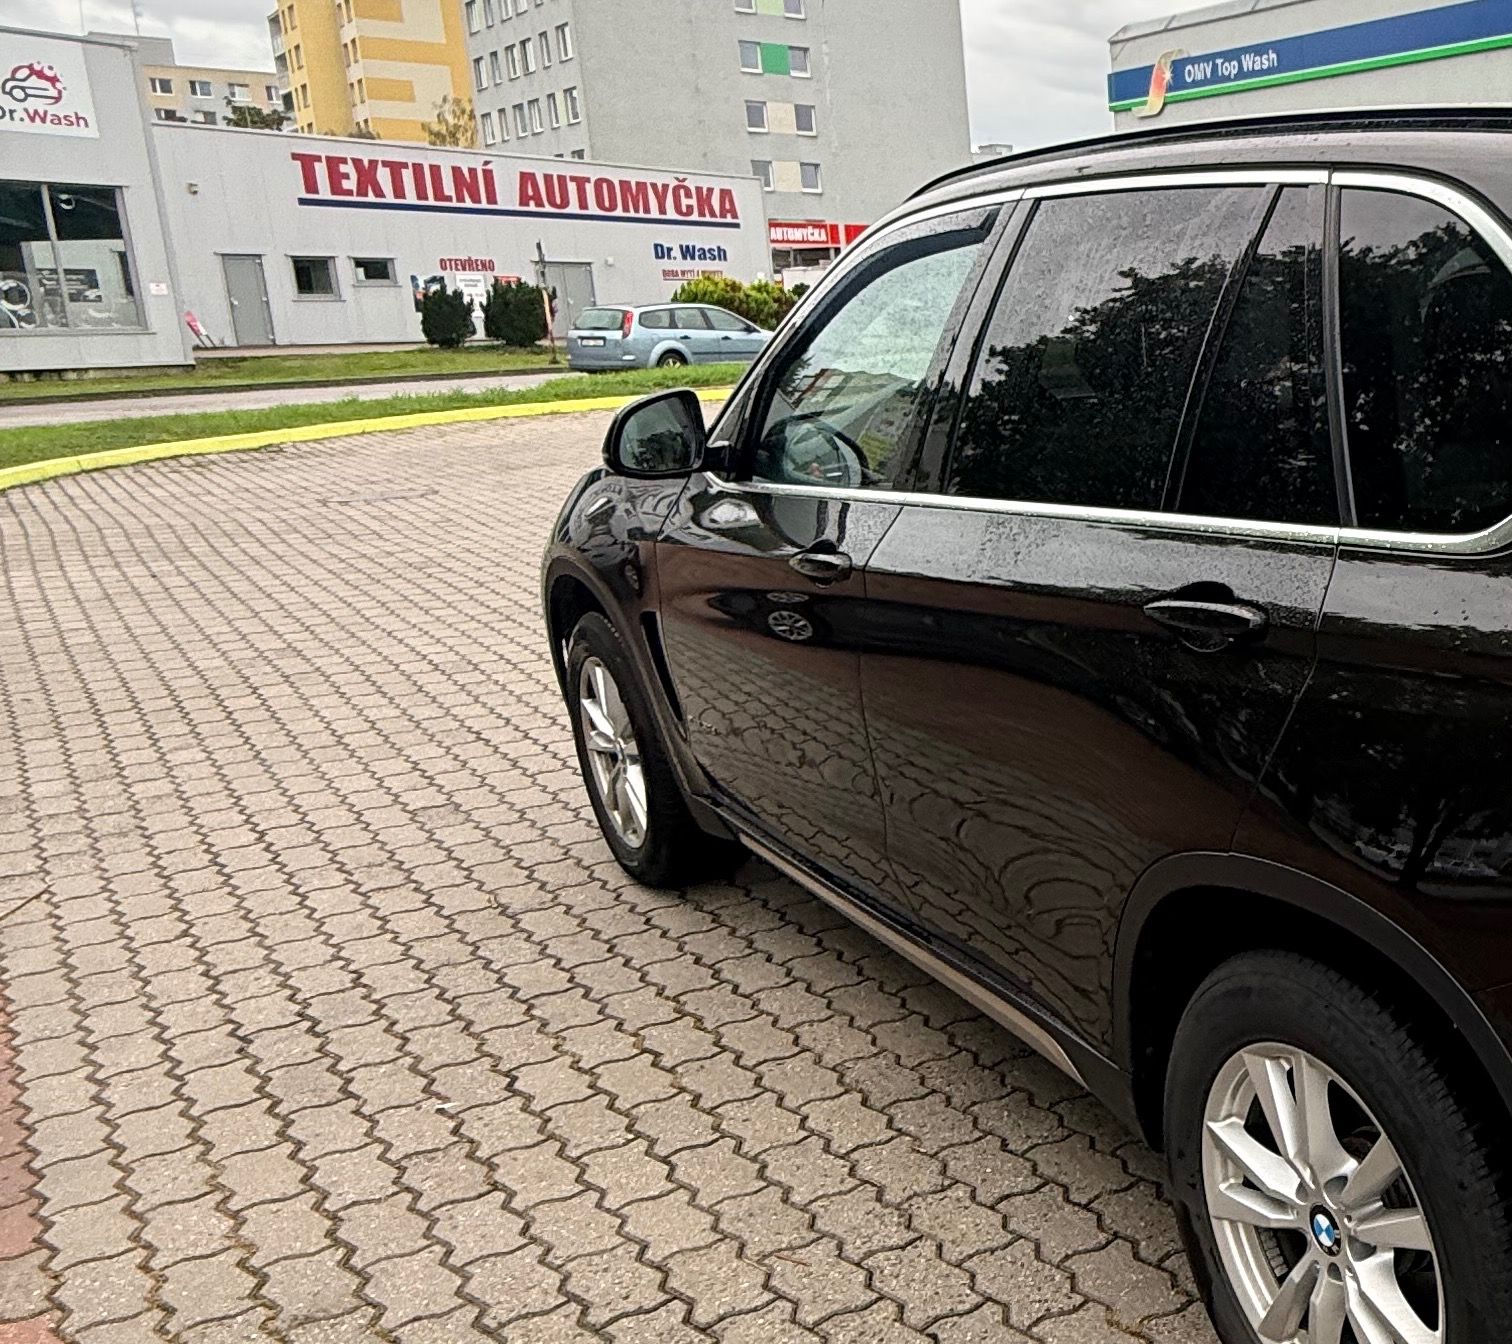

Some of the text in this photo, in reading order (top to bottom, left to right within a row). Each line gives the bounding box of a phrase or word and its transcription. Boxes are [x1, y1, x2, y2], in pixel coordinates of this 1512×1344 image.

[1184, 49, 1278, 83] OMV Top Wash
[291, 152, 739, 219] TEXTILNÍ AUTOMYČKA
[770, 226, 827, 242] AUTOMYČKA
[653, 243, 728, 262] Dr. Wash
[439, 256, 495, 272] OTEVŘENO
